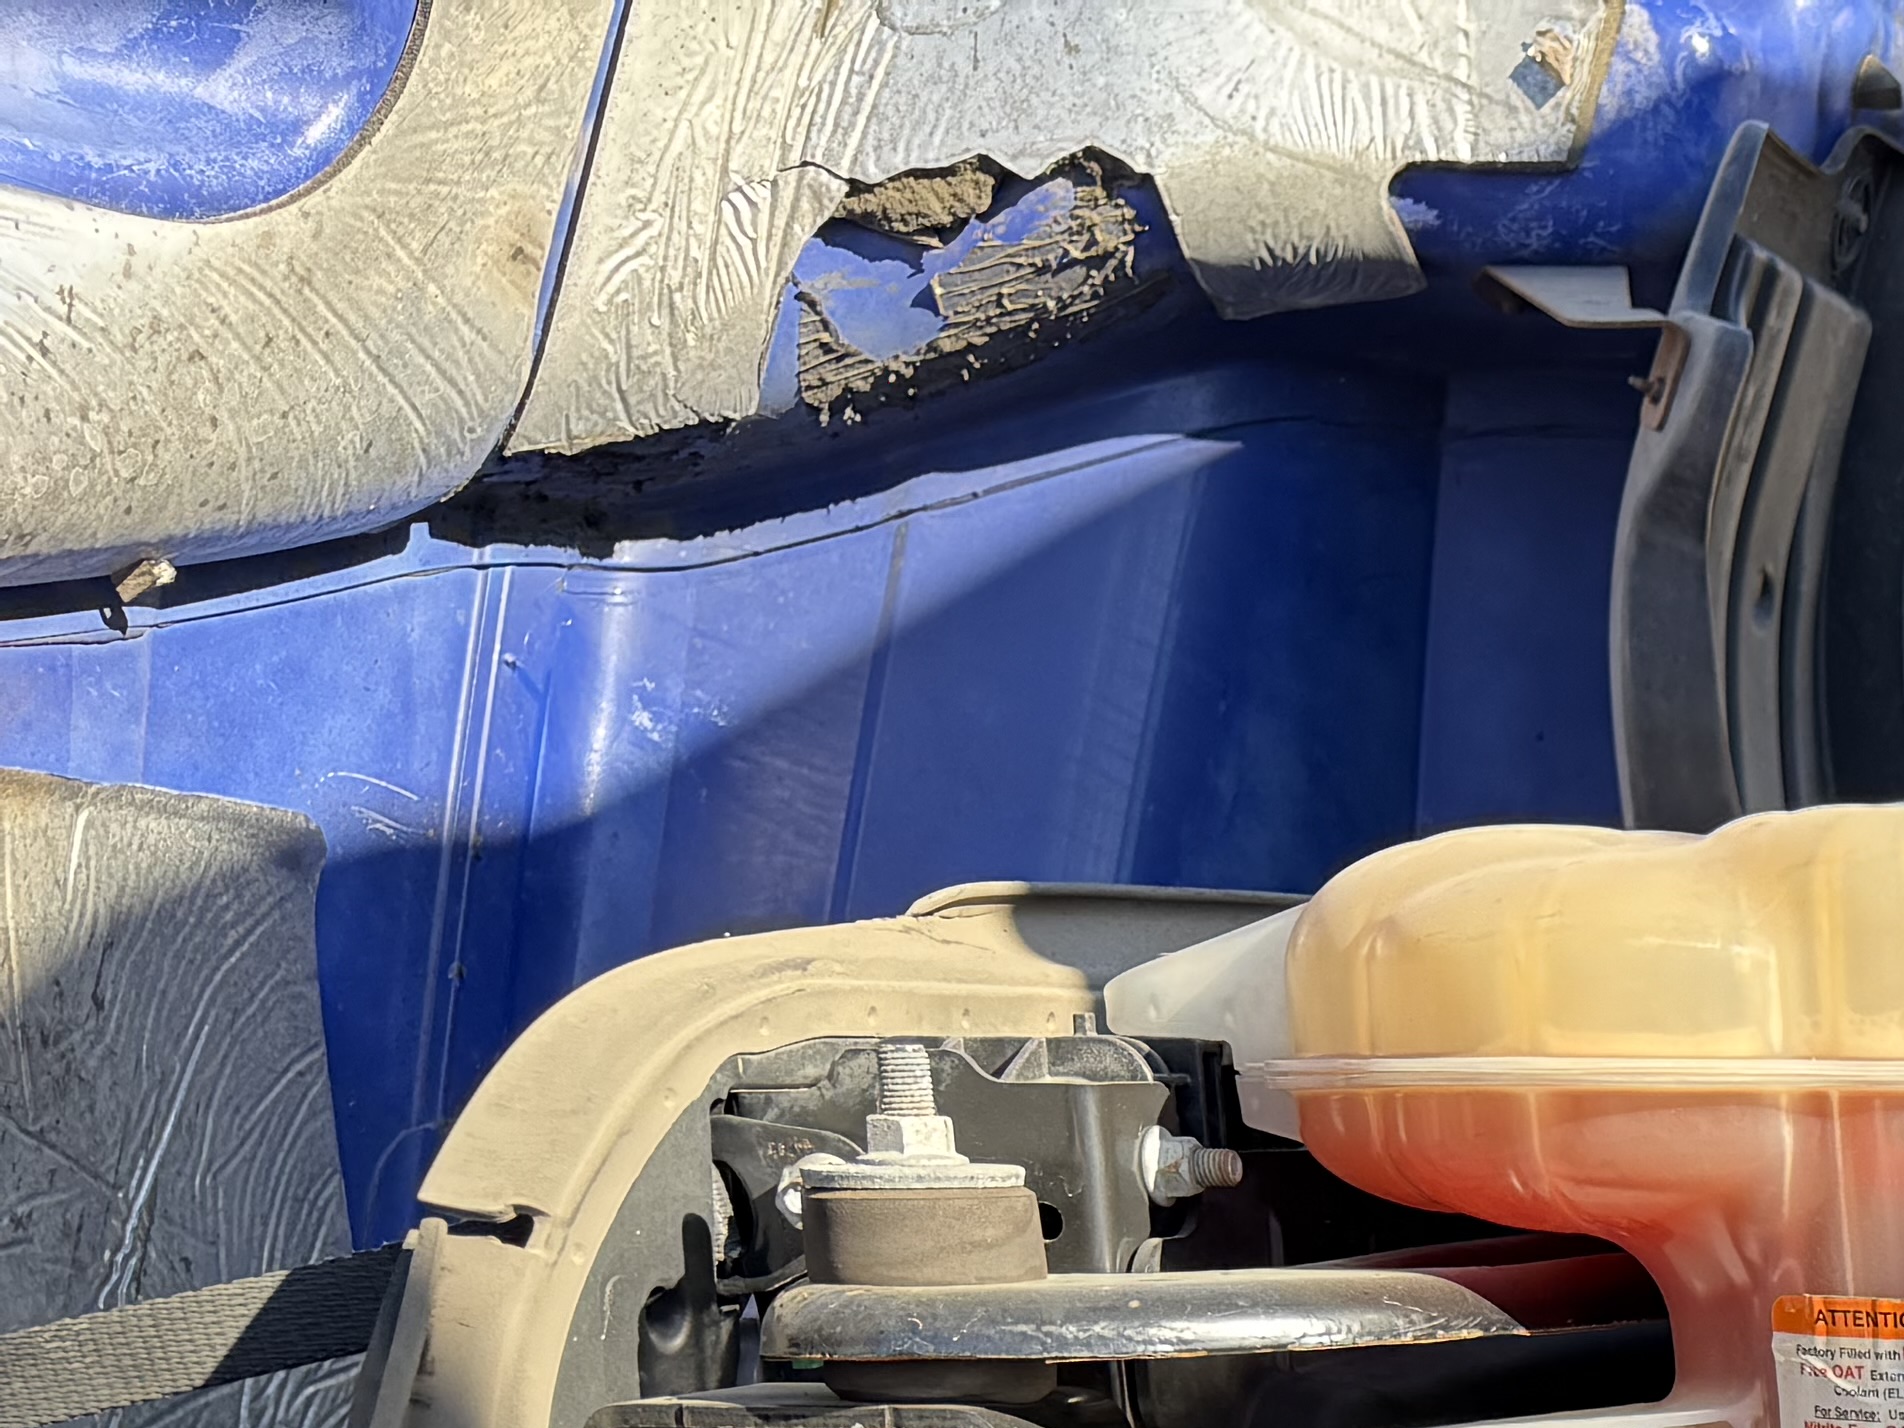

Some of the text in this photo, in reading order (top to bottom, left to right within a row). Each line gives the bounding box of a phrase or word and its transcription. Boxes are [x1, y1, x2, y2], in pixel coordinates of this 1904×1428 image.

[1796, 1344, 1836, 1360] Factory
[1840, 1348, 1870, 1360] Filled
[1874, 1348, 1900, 1360] with
[1833, 1365, 1864, 1379] OAT
[1814, 1405, 1832, 1417] For
[1834, 1407, 1881, 1421] Service:
